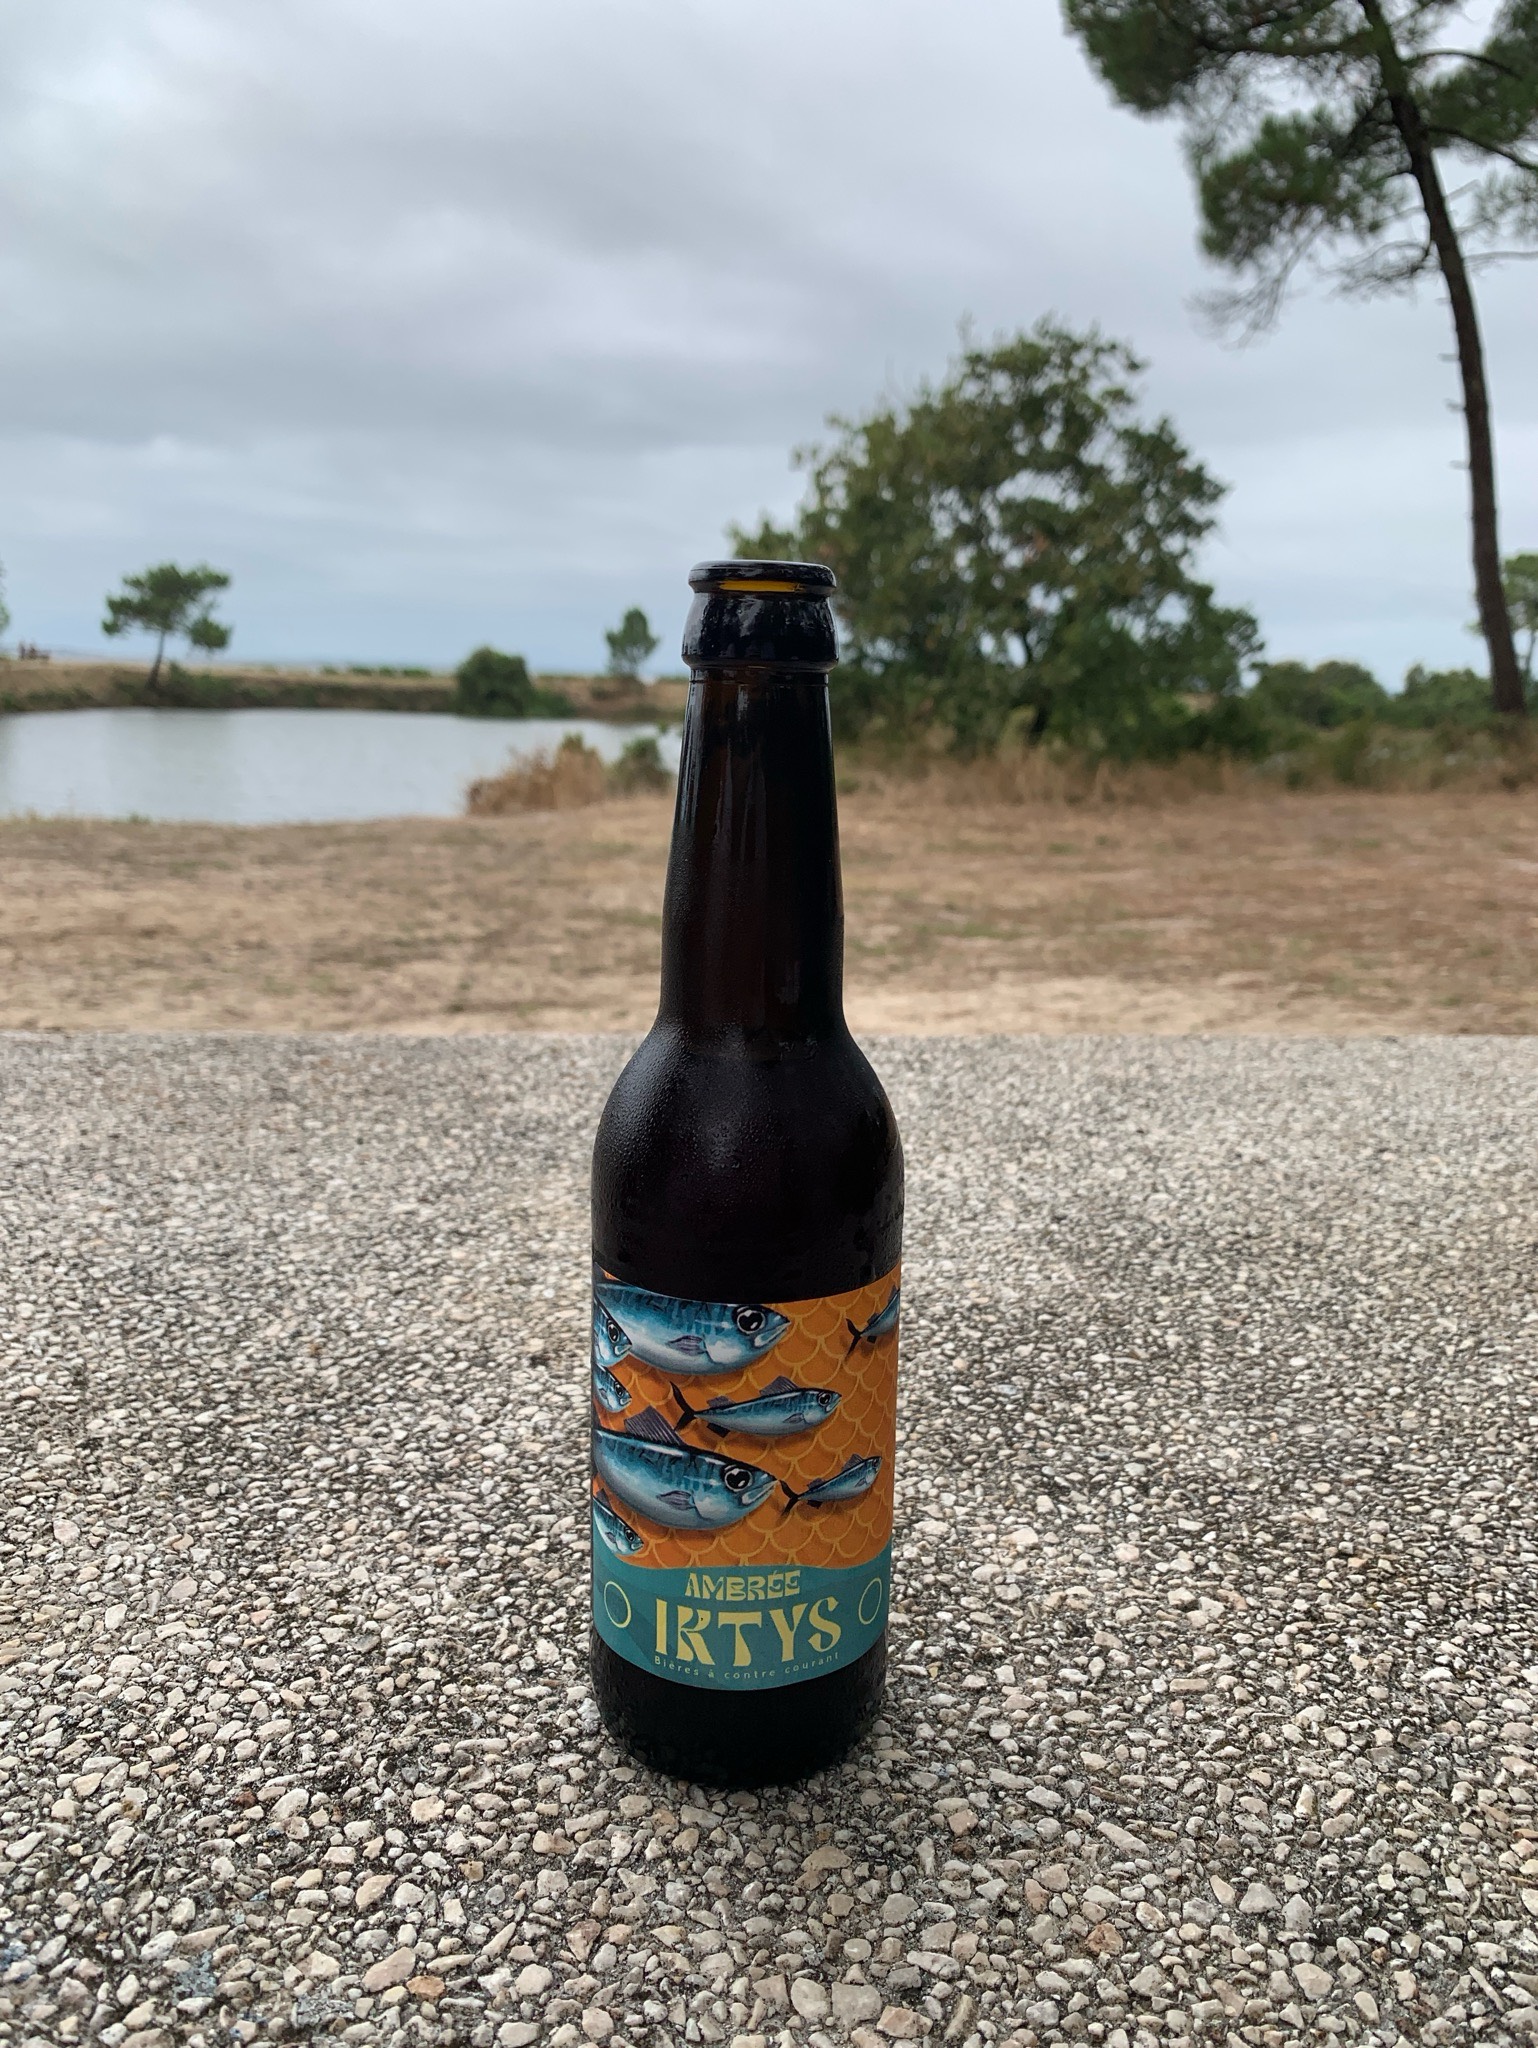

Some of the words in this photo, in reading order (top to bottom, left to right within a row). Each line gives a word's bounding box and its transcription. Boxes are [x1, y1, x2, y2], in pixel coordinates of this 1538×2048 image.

[684, 1569, 801, 1601] AMBRÉE
[654, 1655, 700, 1676] Bières
[708, 1667, 715, 1679] à
[724, 1669, 776, 1680] contre
[784, 1651, 840, 1674] courant
